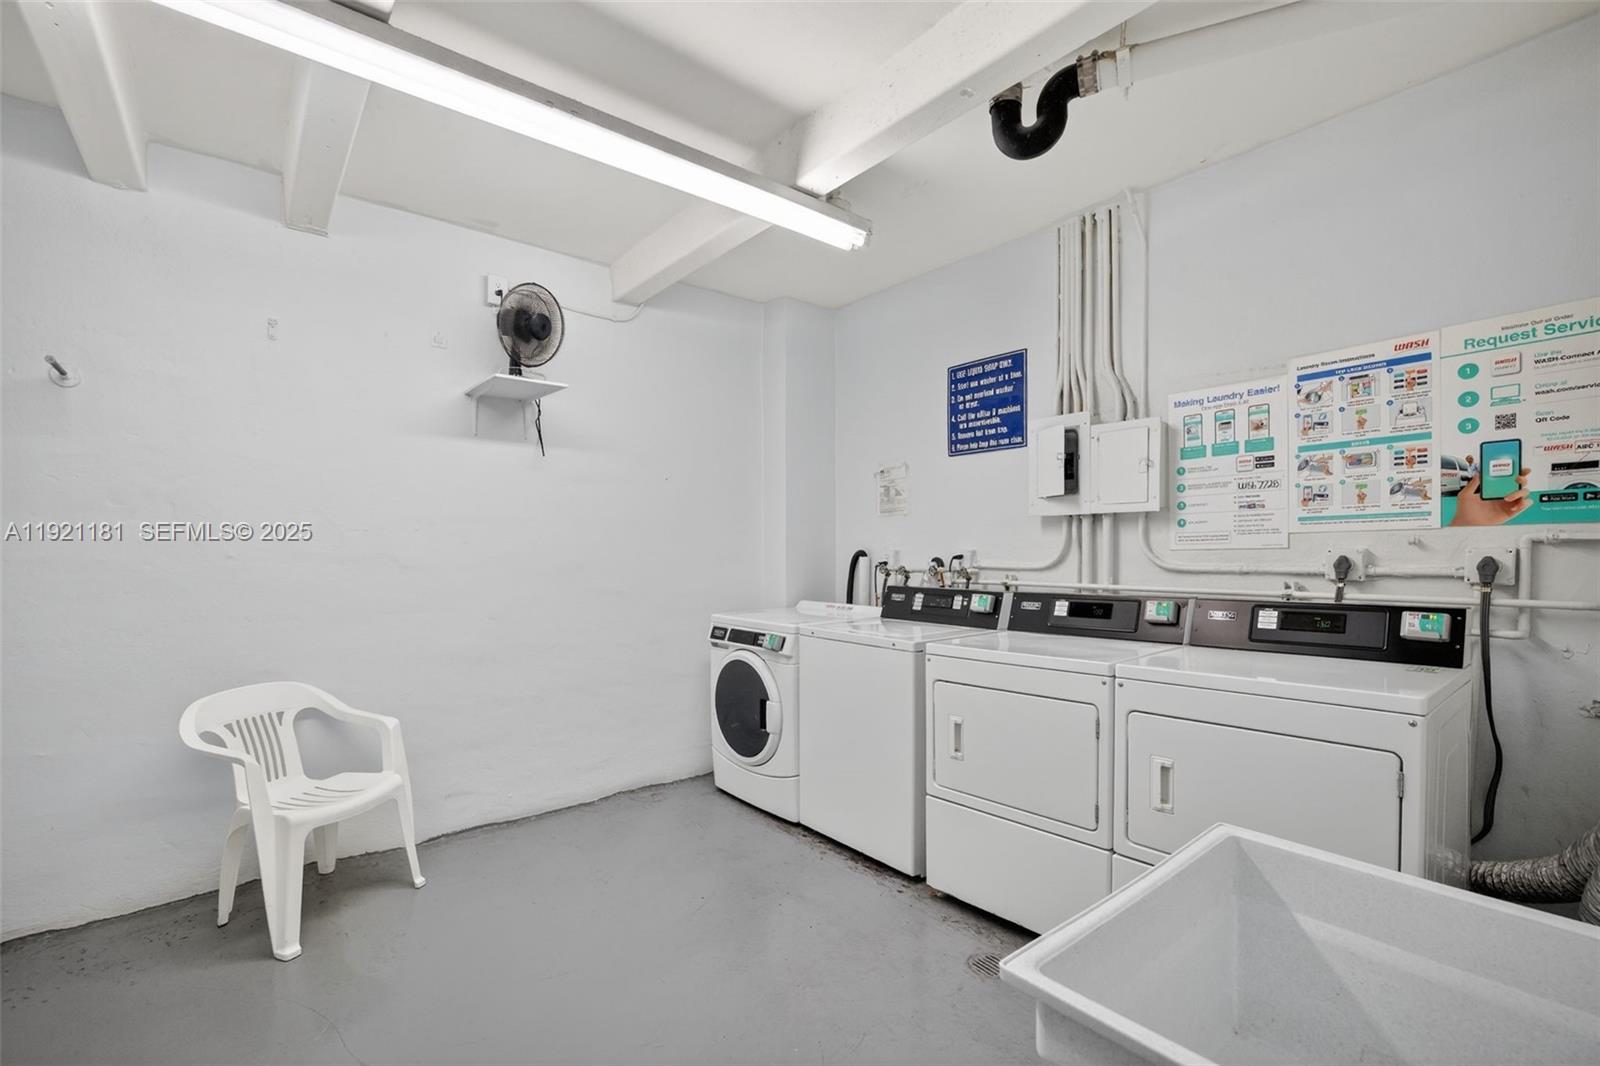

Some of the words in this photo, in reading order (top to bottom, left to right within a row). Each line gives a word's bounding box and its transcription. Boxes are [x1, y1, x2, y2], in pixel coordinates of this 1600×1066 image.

[1394, 338, 1430, 352] WASH
[1464, 327, 1538, 350] Request
[1173, 397, 1205, 409] Making
[1206, 391, 1245, 404] Laundry
[1247, 384, 1281, 397] Easier!
[1549, 414, 1570, 422] Code
